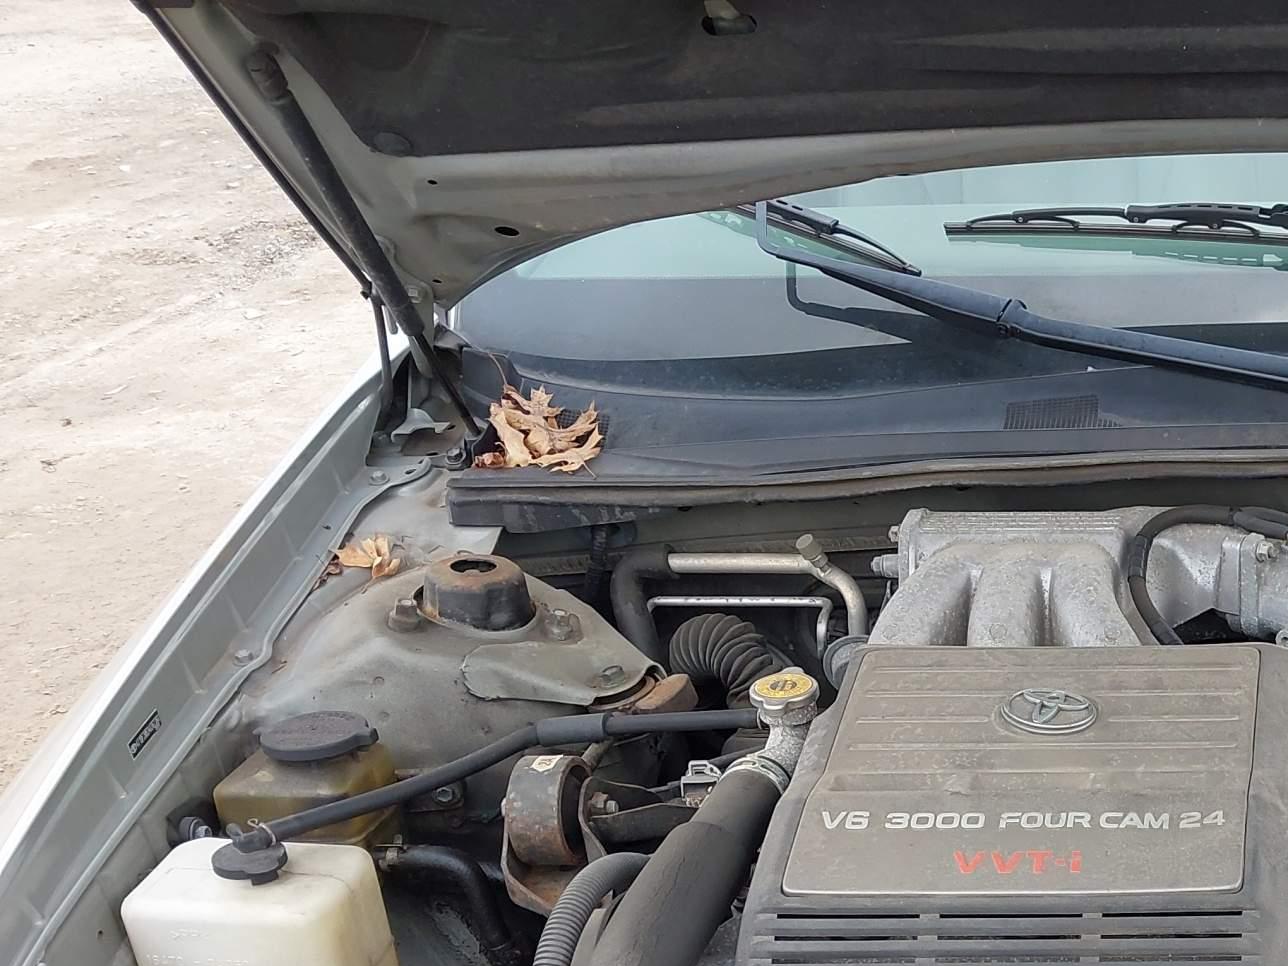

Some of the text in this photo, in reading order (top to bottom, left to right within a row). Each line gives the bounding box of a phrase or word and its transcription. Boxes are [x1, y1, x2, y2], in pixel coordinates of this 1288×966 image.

[821, 810, 1226, 830] V6 3000 FOUR CAM 24
[953, 849, 1083, 875] VVT-i
